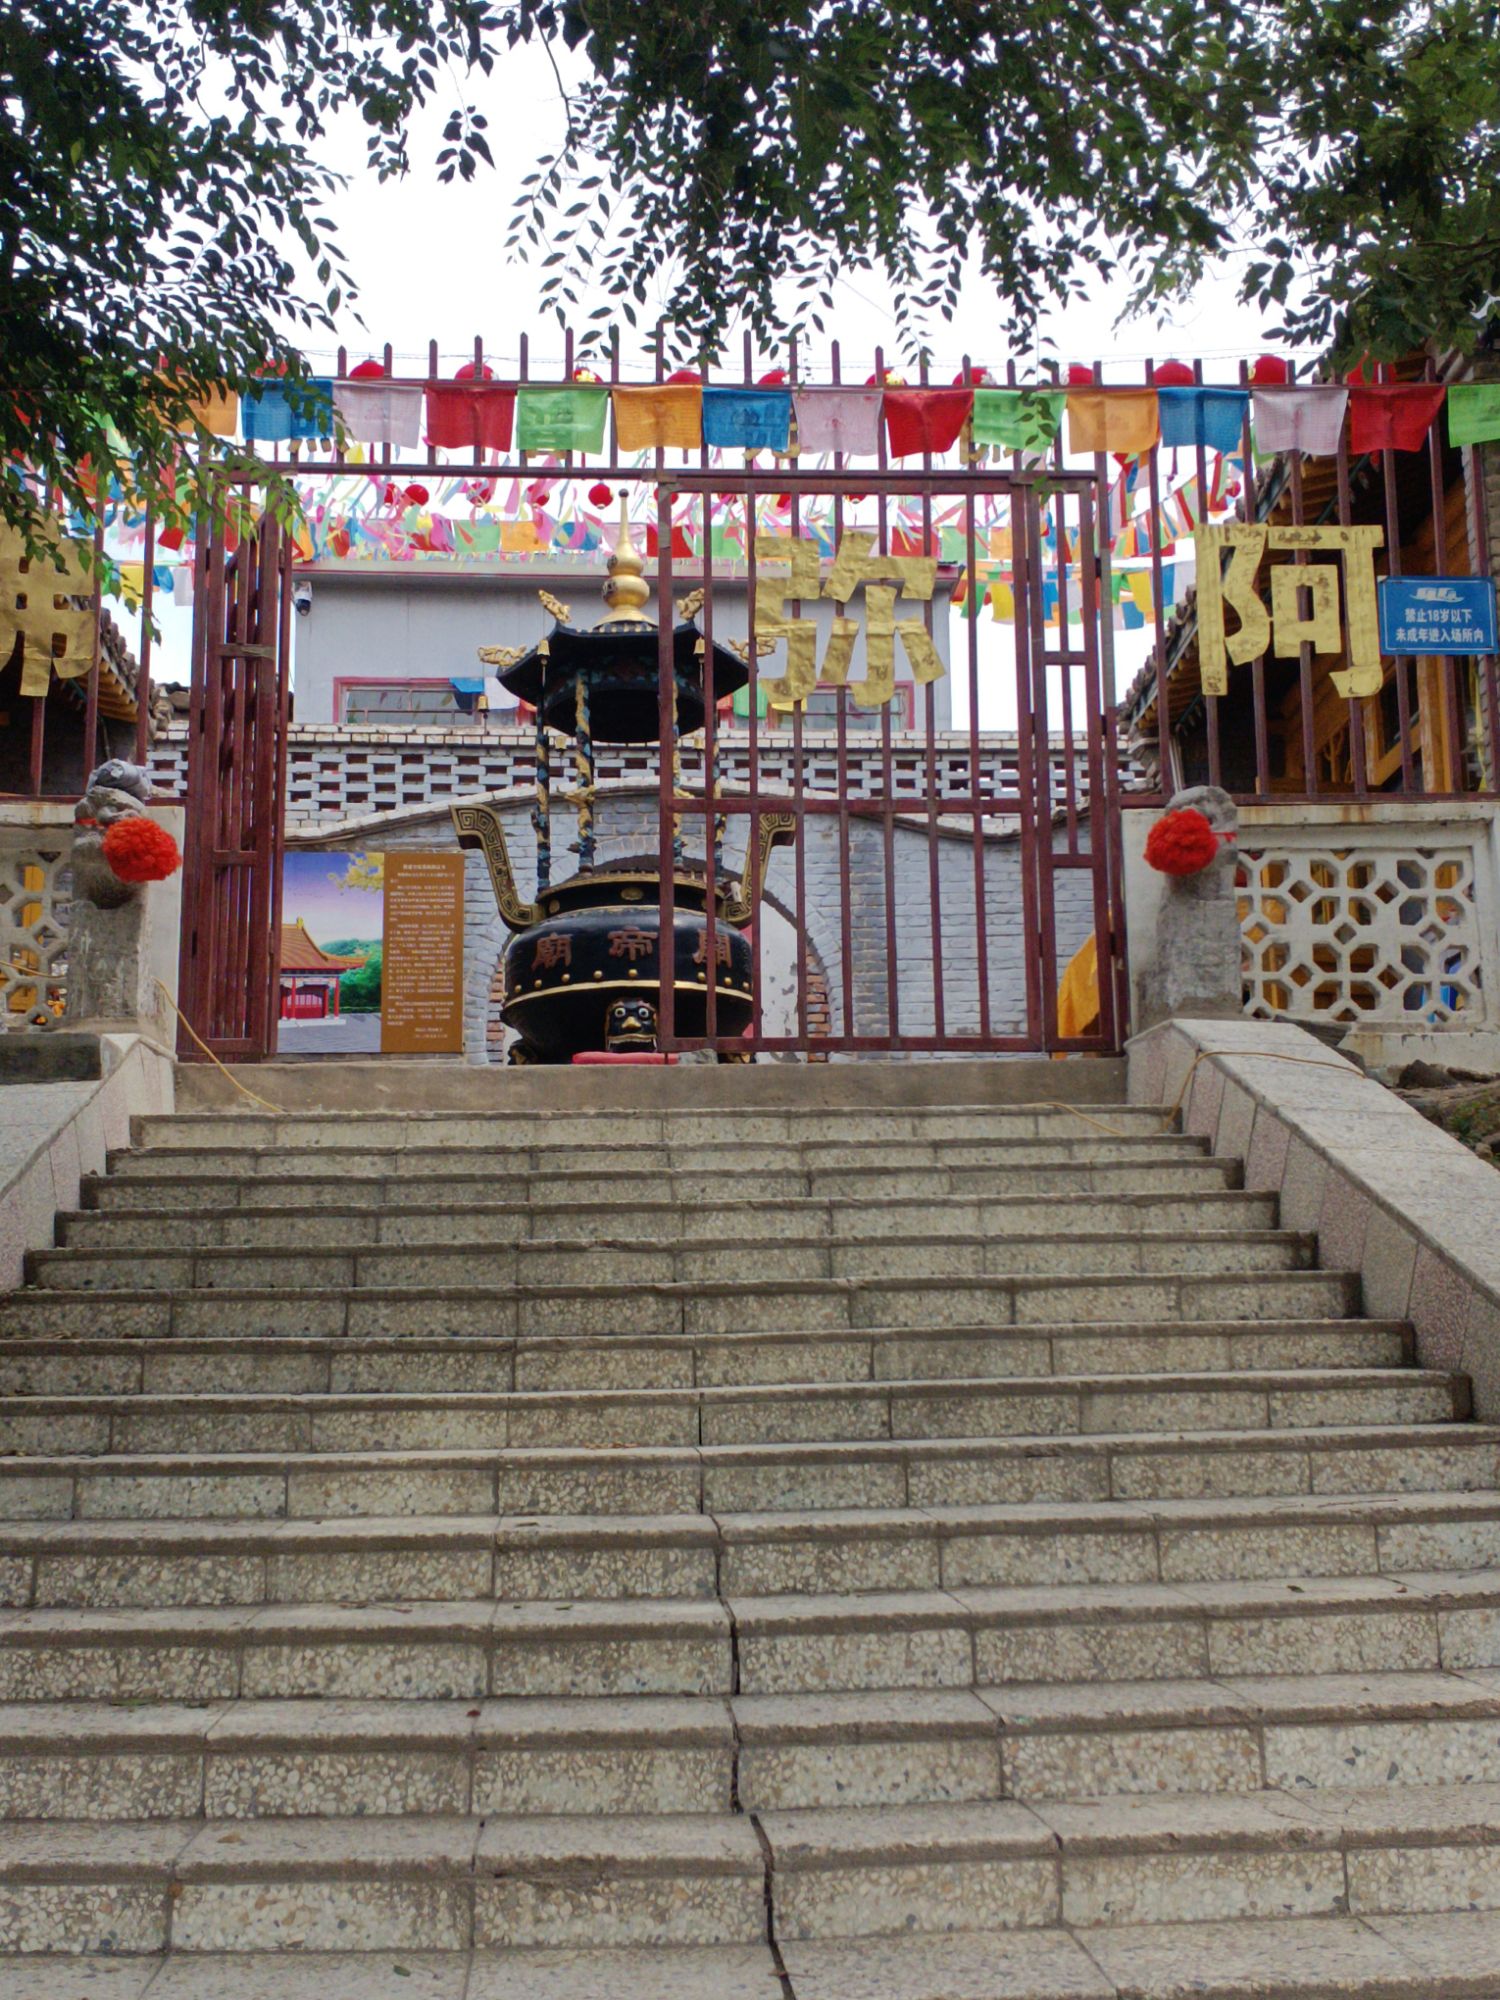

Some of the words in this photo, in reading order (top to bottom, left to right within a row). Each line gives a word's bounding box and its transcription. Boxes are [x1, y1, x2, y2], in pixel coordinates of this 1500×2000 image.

[754, 529, 946, 706] 弥
[1194, 523, 1384, 698] 阿
[1405, 608, 1472, 623] 禁止18岁以下
